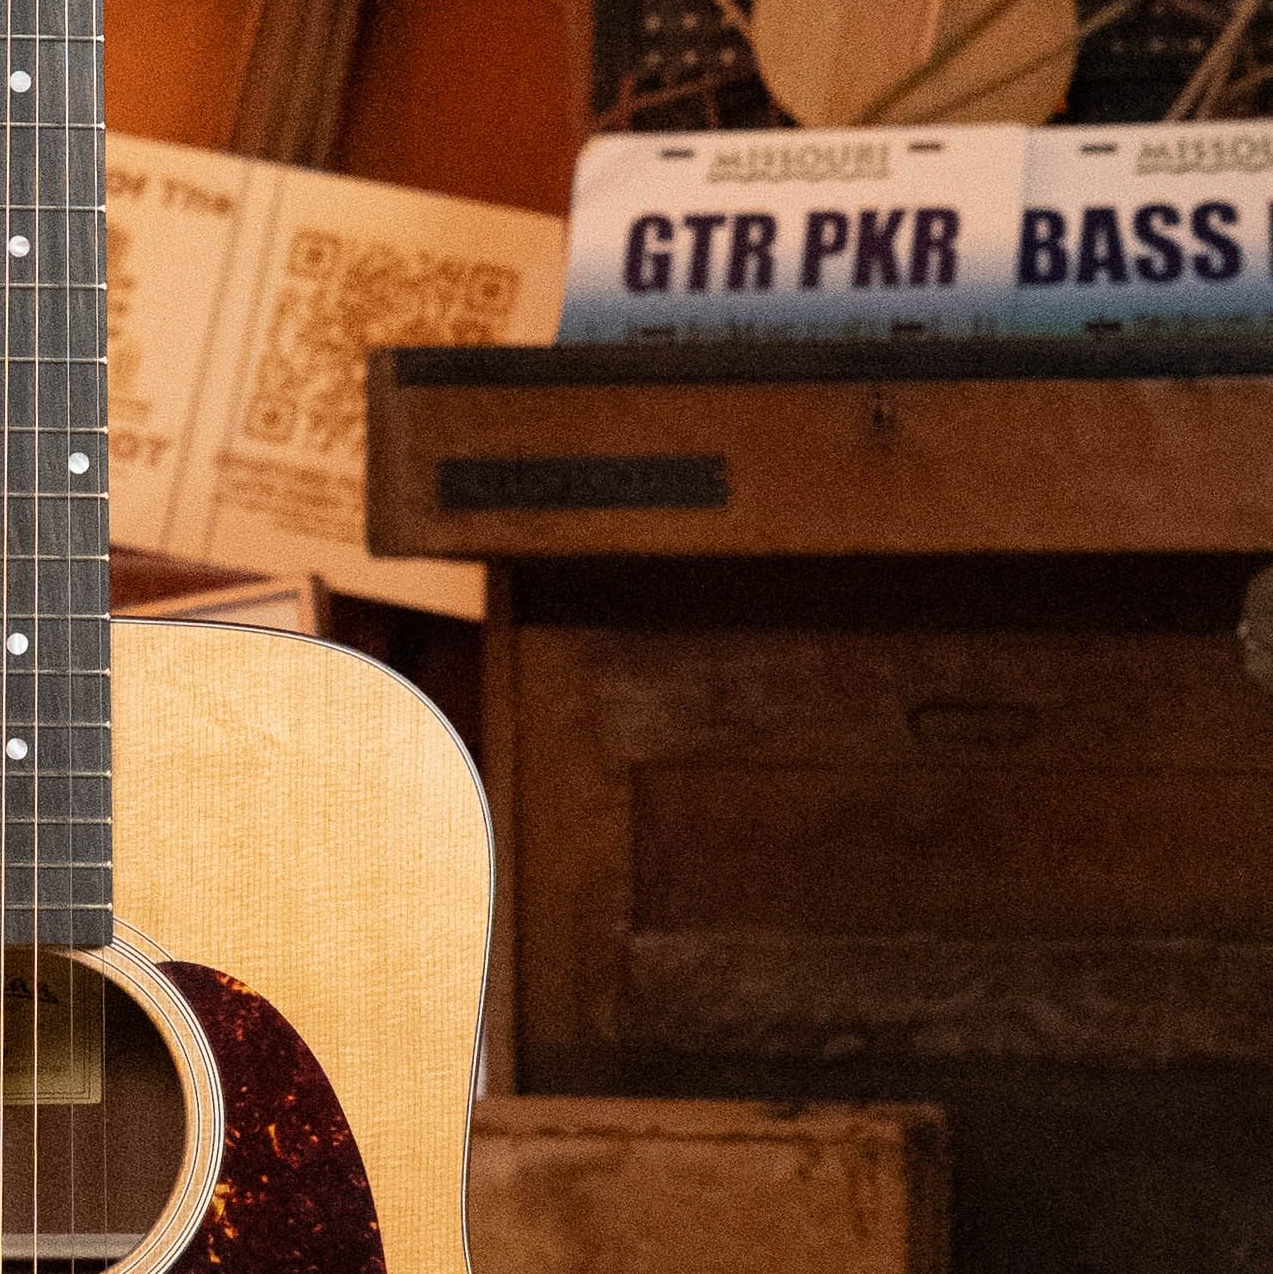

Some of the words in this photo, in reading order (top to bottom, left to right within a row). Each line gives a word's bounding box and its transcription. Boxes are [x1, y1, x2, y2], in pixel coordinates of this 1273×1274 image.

[707, 144, 893, 184] MISSOURI
[624, 212, 778, 294] GTR
[800, 206, 961, 290] PKR
[1016, 200, 1244, 287] BASS
